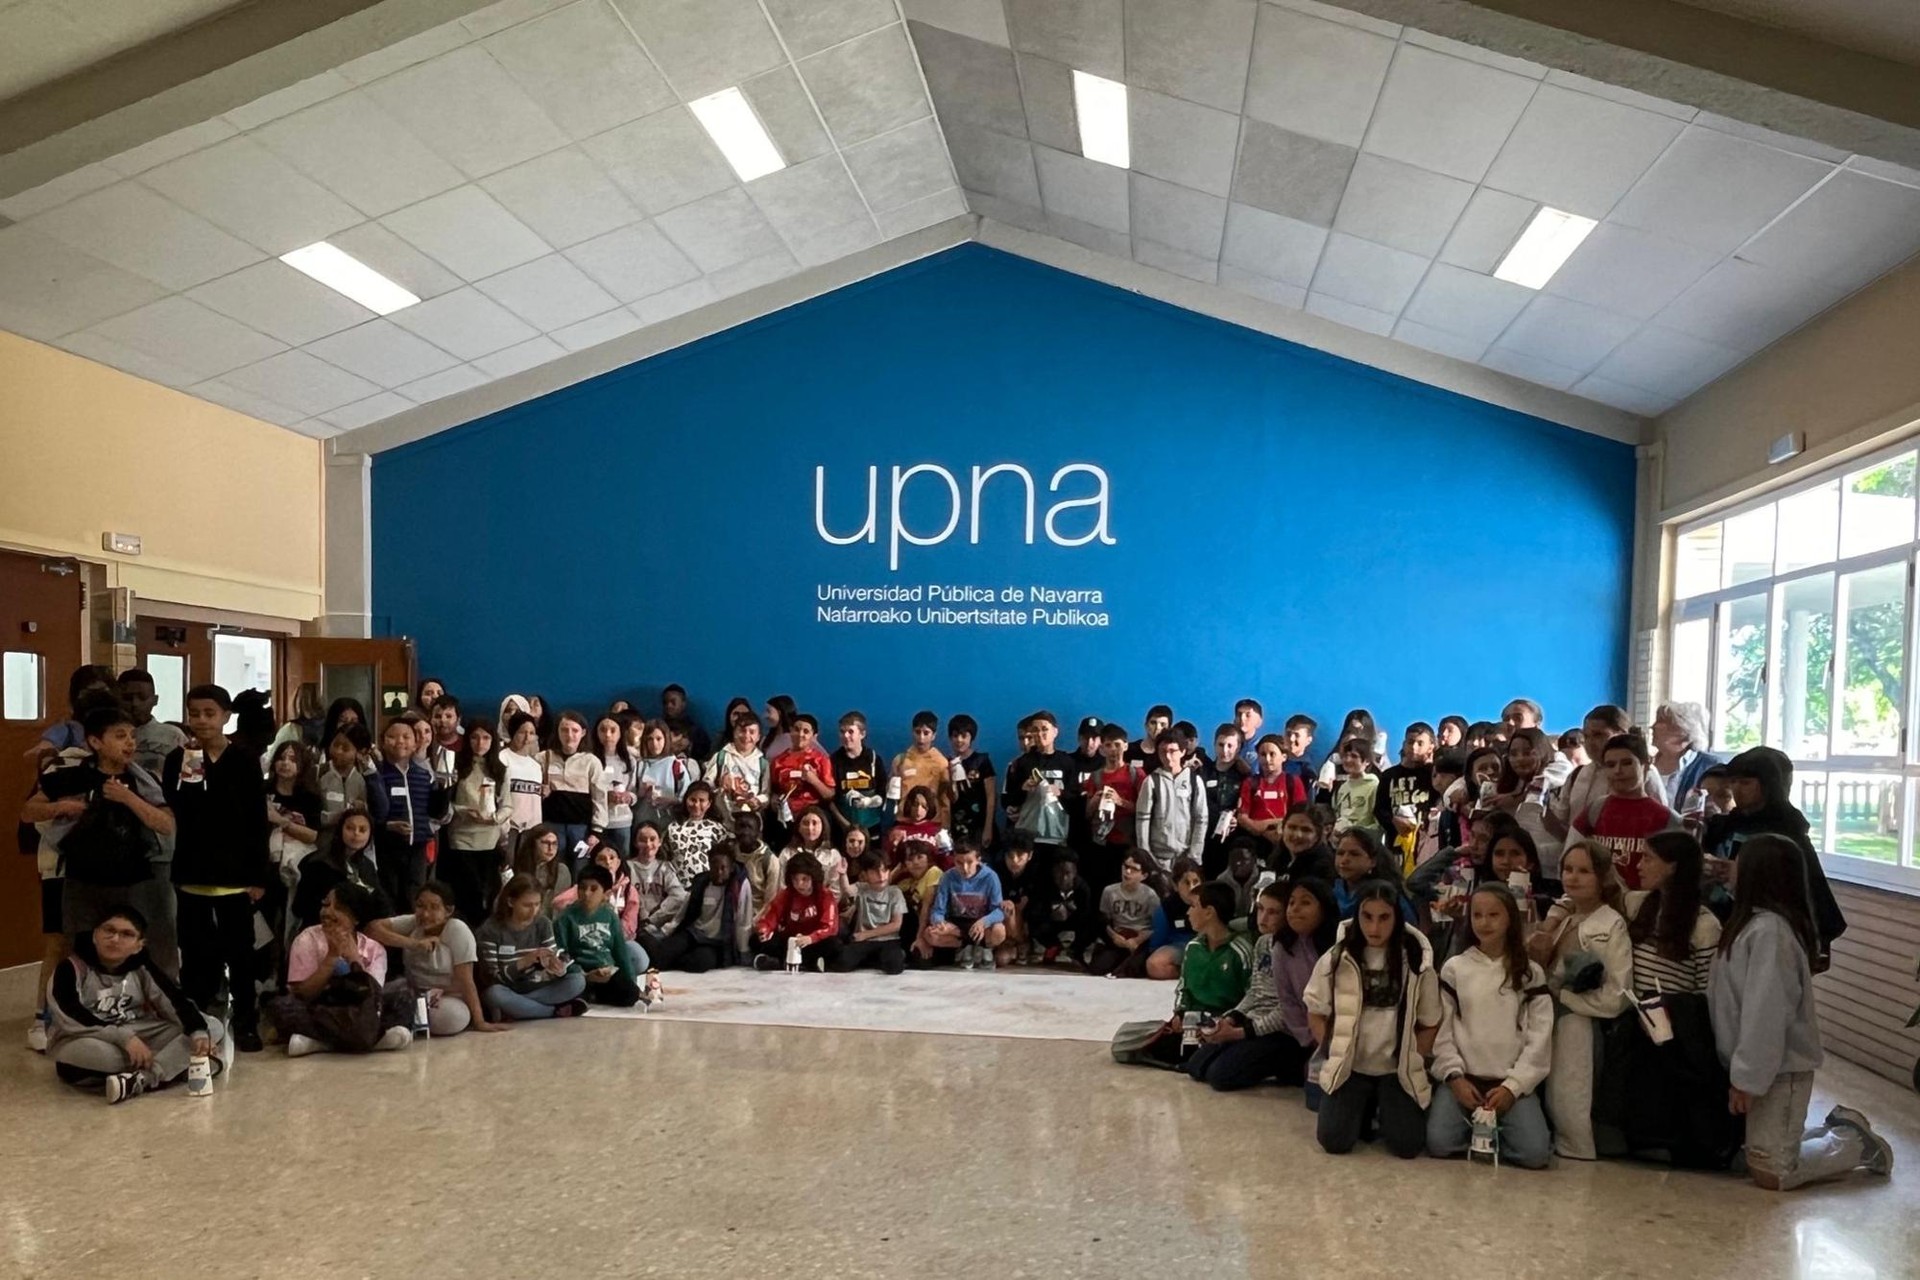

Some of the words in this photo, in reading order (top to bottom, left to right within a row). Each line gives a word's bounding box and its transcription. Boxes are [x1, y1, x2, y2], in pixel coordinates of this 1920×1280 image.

[815, 463, 1117, 571] upna
[817, 584, 922, 602] Universidad
[928, 584, 995, 603] Pública
[1000, 586, 1025, 603] de
[1030, 586, 1103, 604] Navarra
[817, 606, 912, 624] Nafarroako
[917, 607, 1028, 626] Unibertsitate
[1032, 607, 1110, 627] Publikoa
[1112, 899, 1143, 918] GAP
